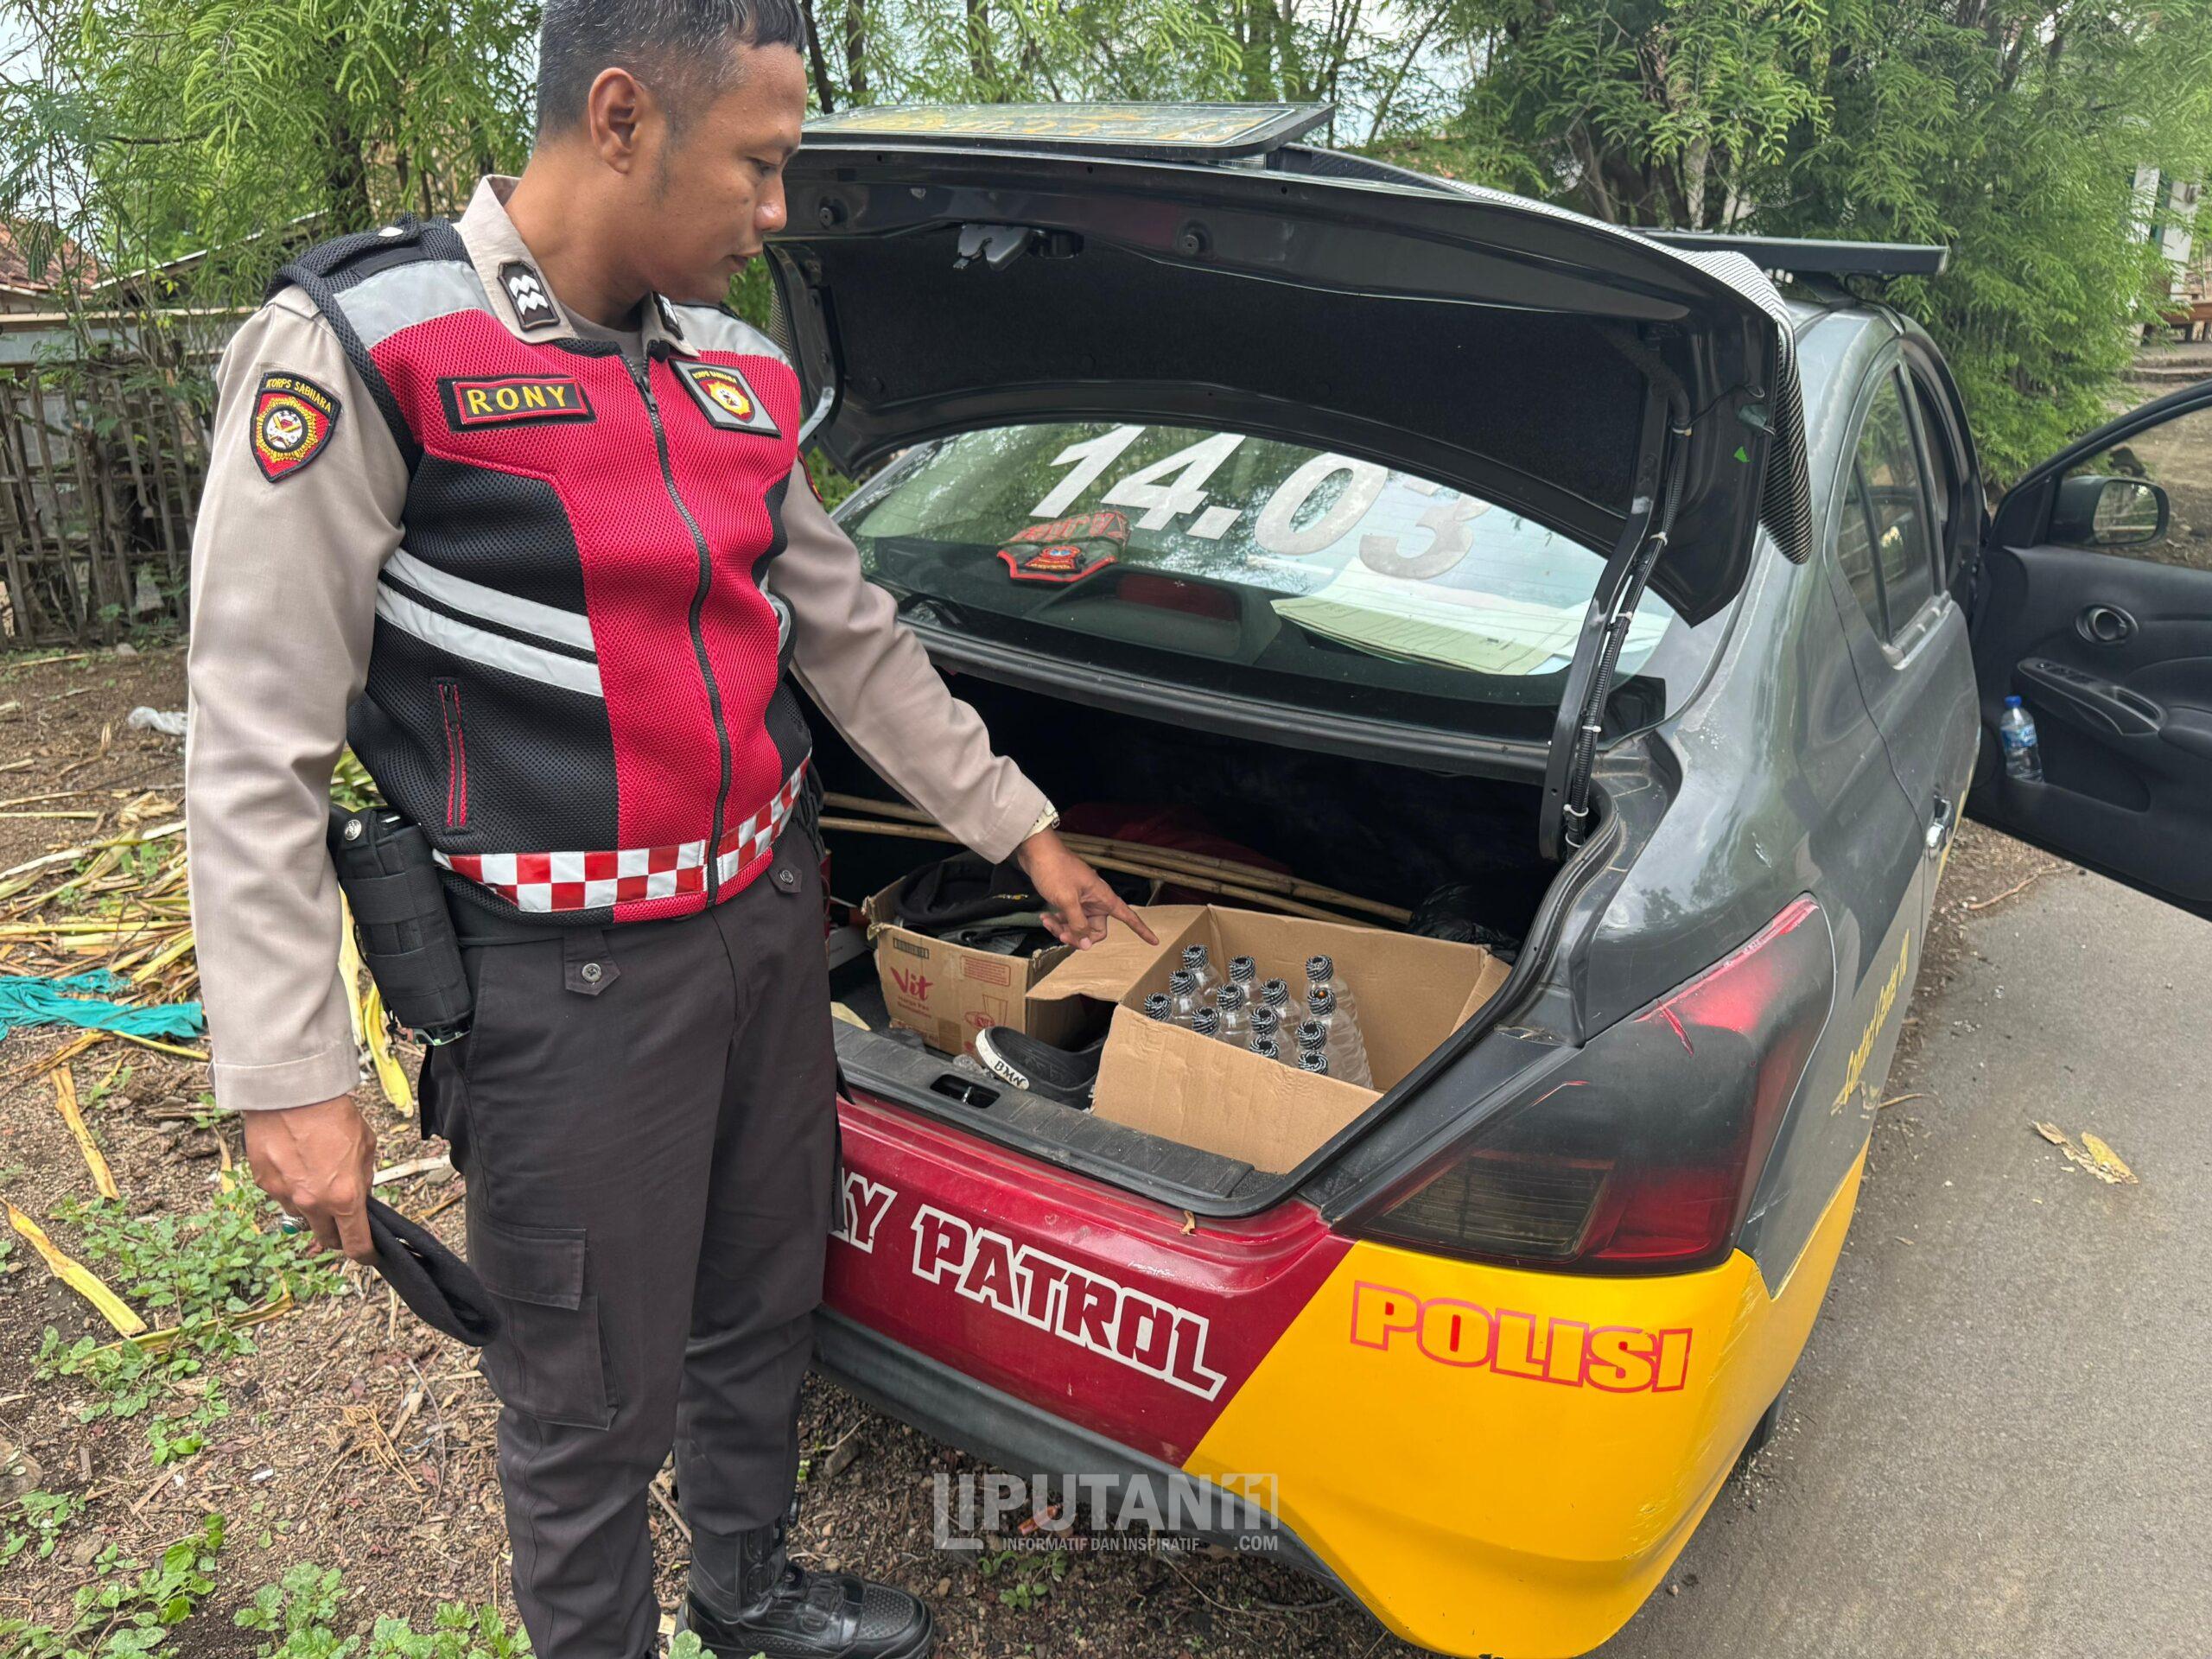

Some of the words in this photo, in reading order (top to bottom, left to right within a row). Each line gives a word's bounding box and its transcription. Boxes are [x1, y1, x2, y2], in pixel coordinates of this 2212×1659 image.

[265, 378, 292, 389] KORPS
[467, 385, 567, 415] RONY
[1030, 425, 1493, 581] 14.03
[890, 966, 933, 1001] Vit
[911, 1204, 1227, 1402] PATROL
[1351, 1280, 1694, 1394] POLISI
